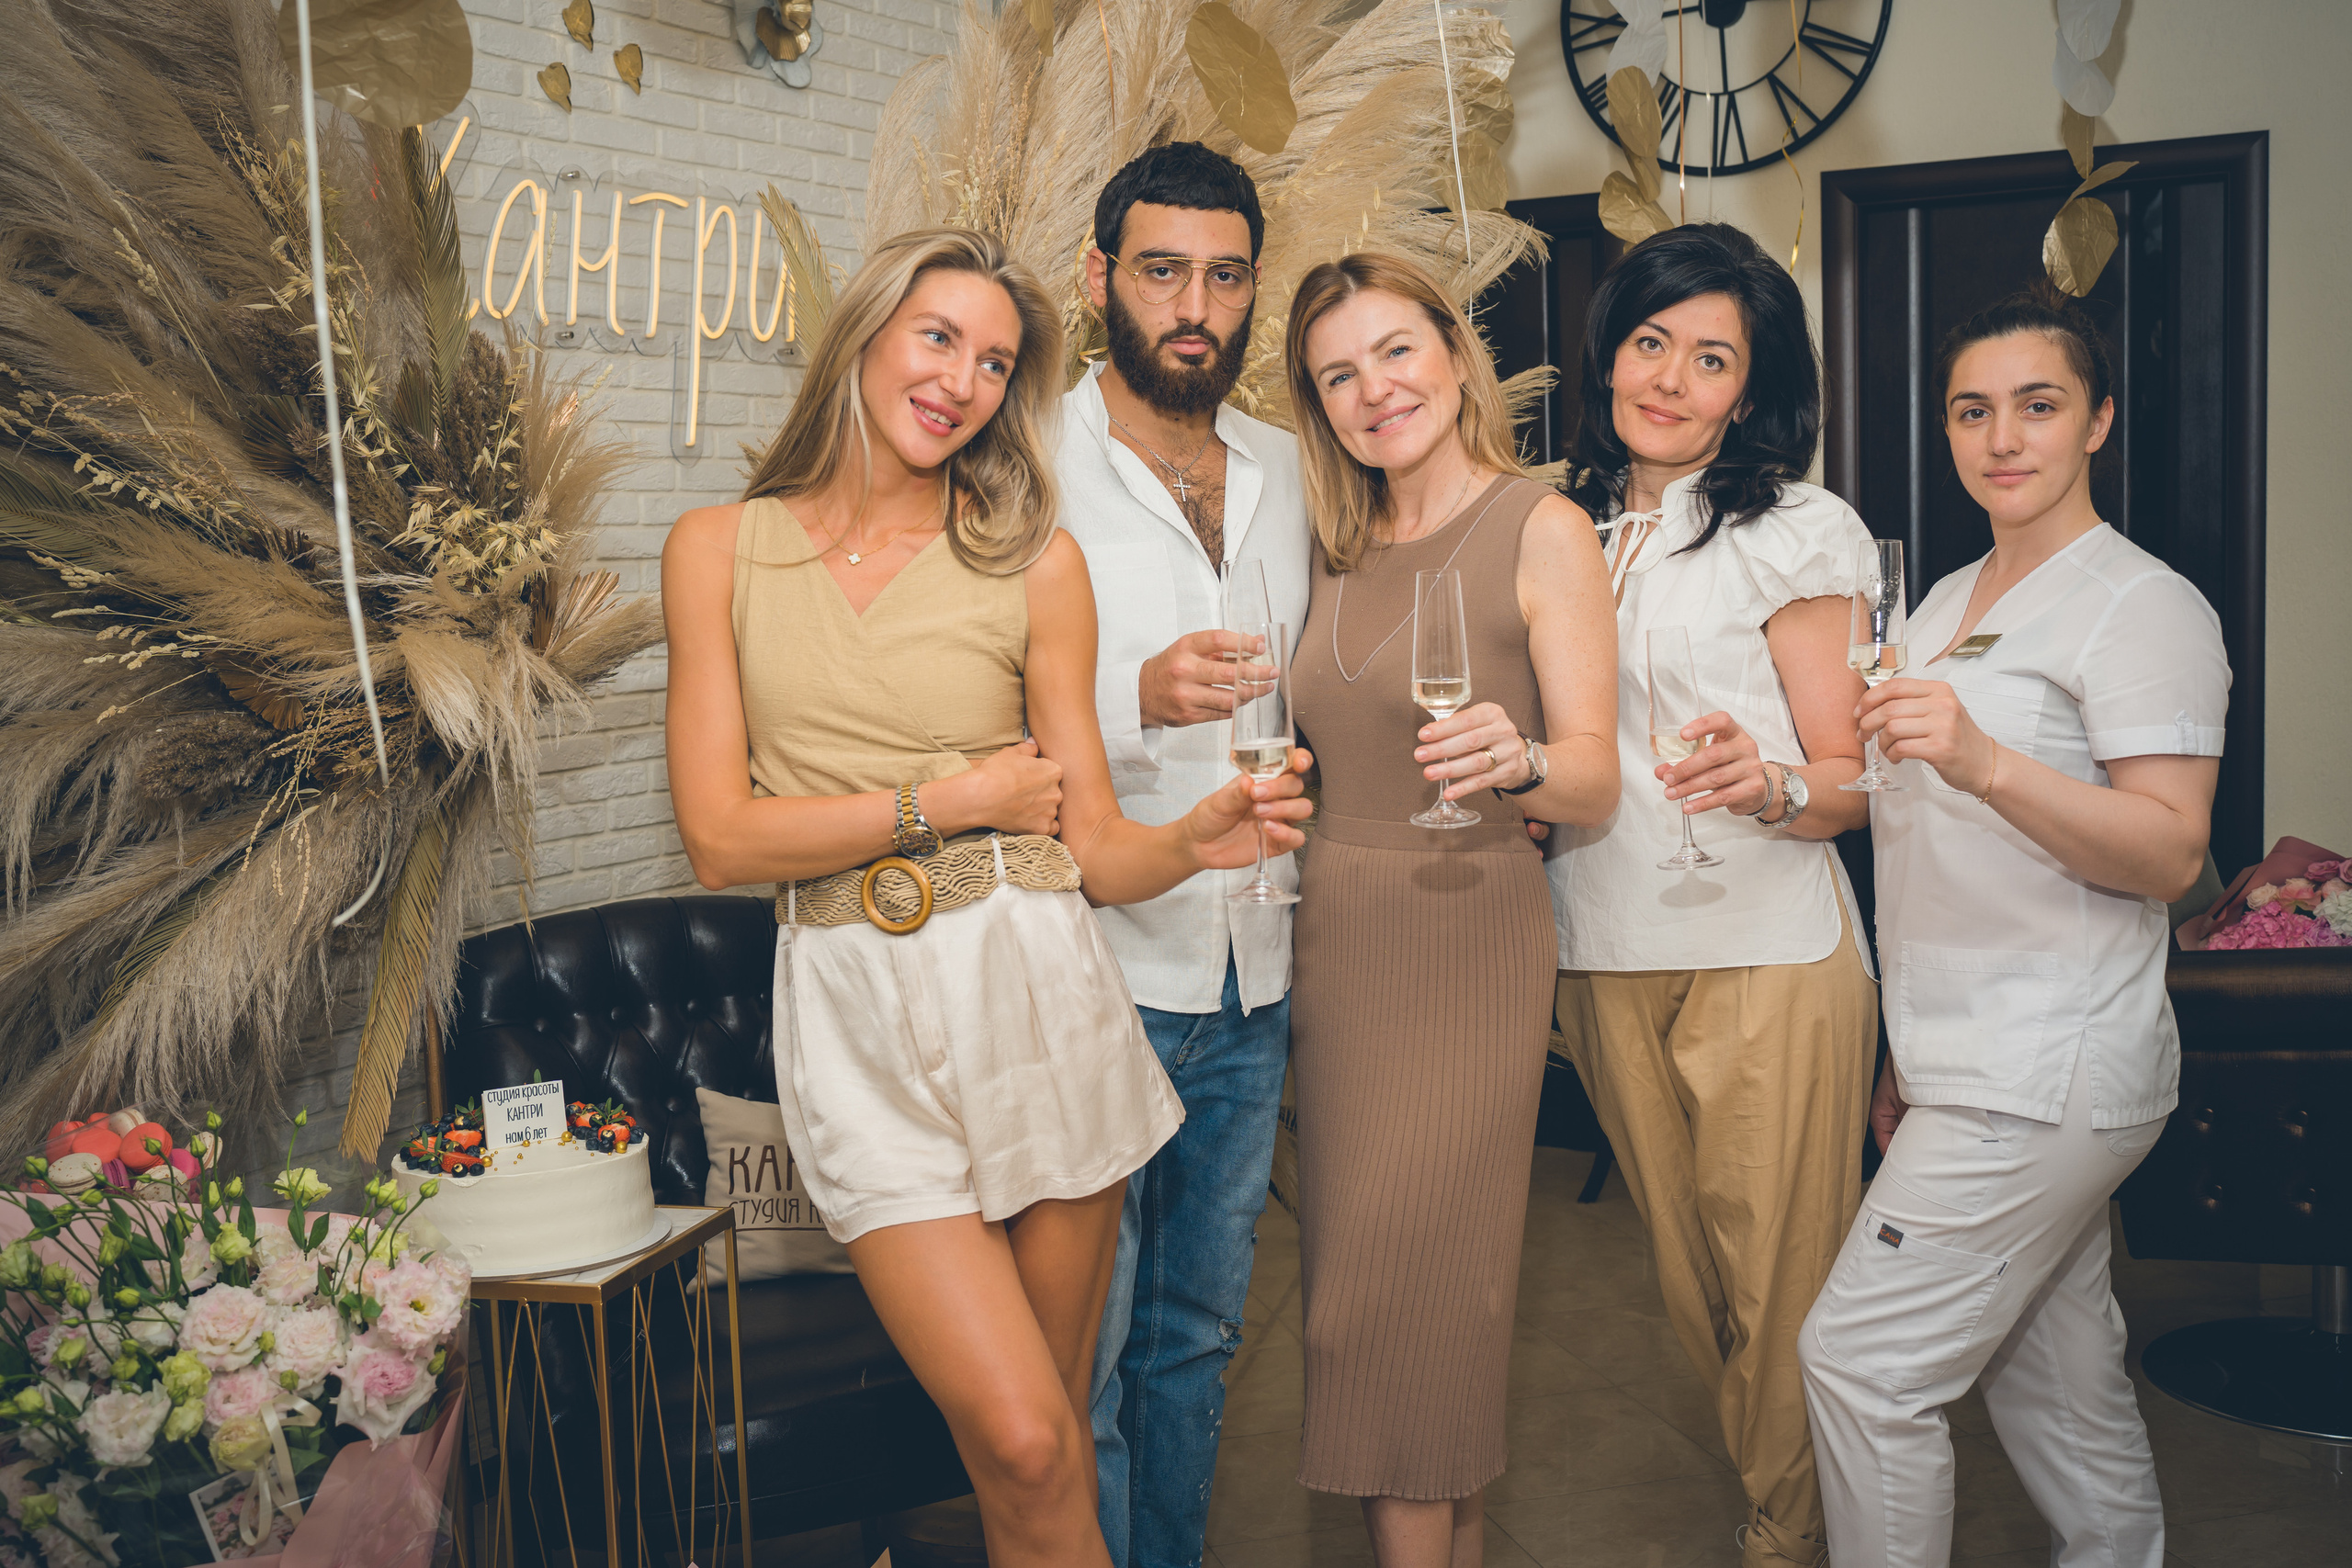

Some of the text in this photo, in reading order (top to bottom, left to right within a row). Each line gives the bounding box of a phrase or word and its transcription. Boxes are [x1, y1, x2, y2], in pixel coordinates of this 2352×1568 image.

[487, 1083, 560, 1106] студия красоты
[506, 1102, 544, 1122] КАНТРИ
[505, 1125, 548, 1144] нам 6 лет
